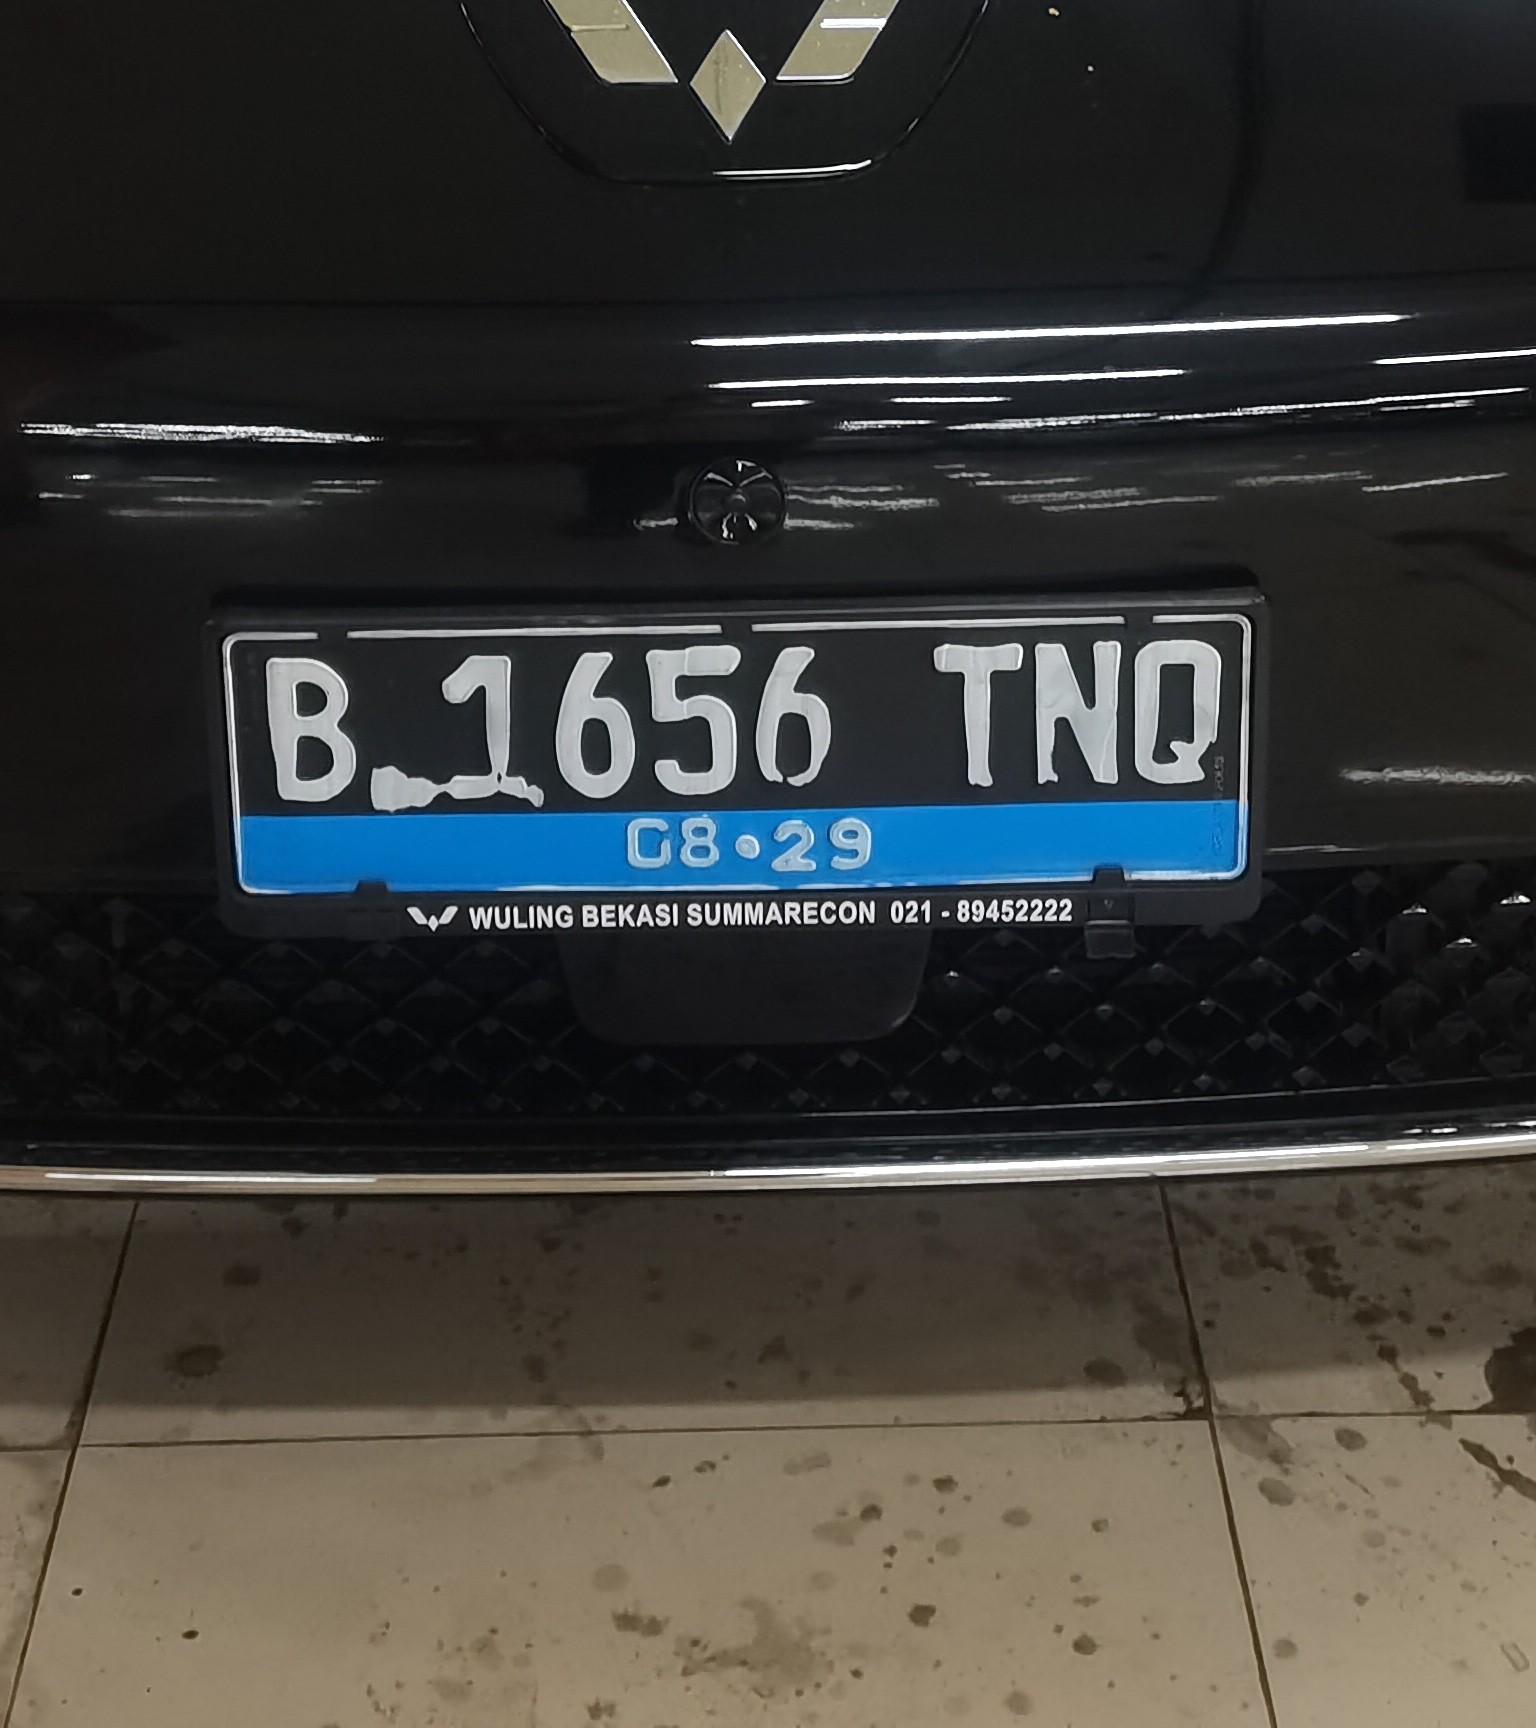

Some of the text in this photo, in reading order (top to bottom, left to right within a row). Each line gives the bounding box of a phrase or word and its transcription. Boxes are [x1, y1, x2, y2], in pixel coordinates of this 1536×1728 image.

[264, 638, 1223, 810] B 1656 TNQ
[467, 903, 575, 931] WULING
[580, 901, 680, 929] BEKASI
[685, 899, 877, 928] SUMMARECON
[889, 898, 932, 925] 021
[955, 897, 1074, 924] 89452222
